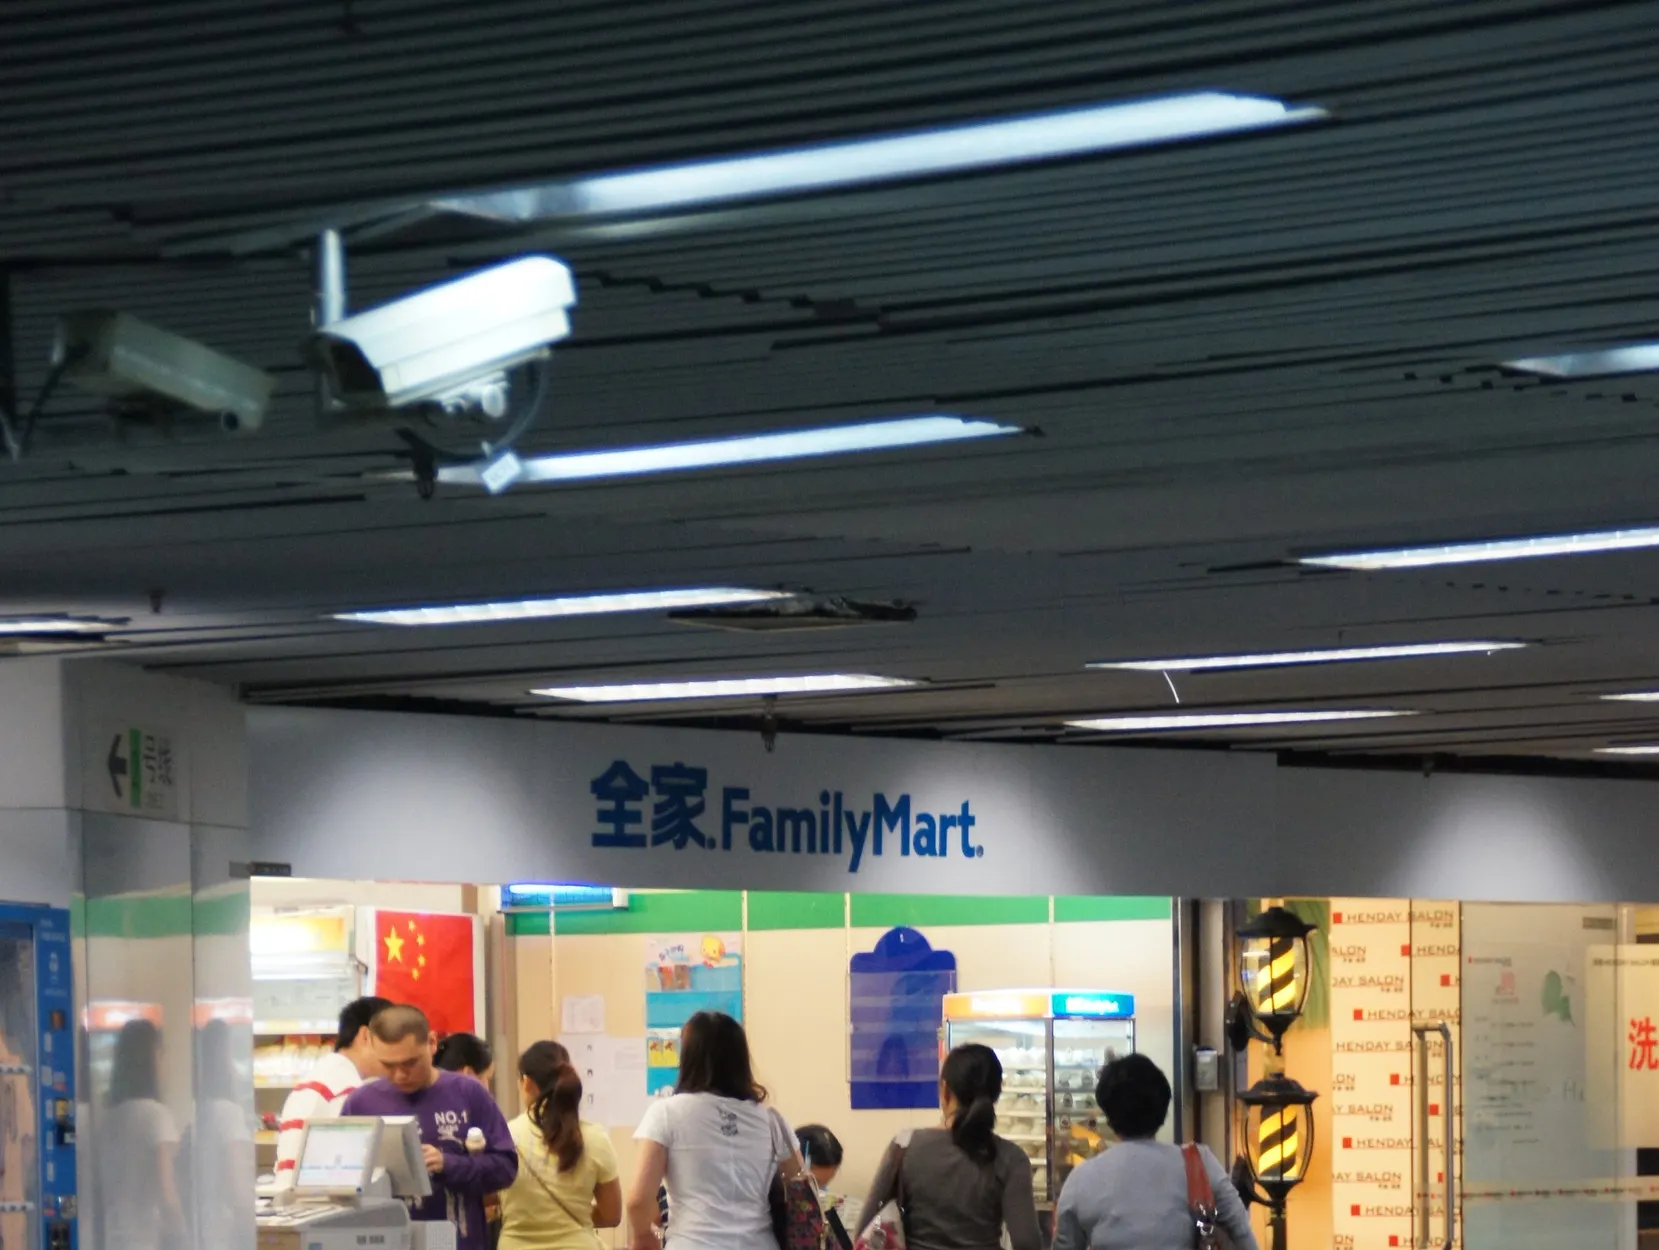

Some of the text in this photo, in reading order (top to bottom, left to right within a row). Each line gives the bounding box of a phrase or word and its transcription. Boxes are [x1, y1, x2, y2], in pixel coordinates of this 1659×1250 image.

[722, 787, 977, 873] FamilyMart
[1347, 910, 1454, 923] HENDAY SALON
[1359, 975, 1404, 986] SALON
[1368, 1010, 1424, 1020] HENDAY
[1336, 1041, 1391, 1051] HENDAY
[1628, 1017, 1659, 1071] 洗
[1349, 1104, 1393, 1114] SALON
[434, 1110, 468, 1125] NO.1
[1357, 1138, 1412, 1148] HENDAY
[1356, 1172, 1402, 1182] SALON
